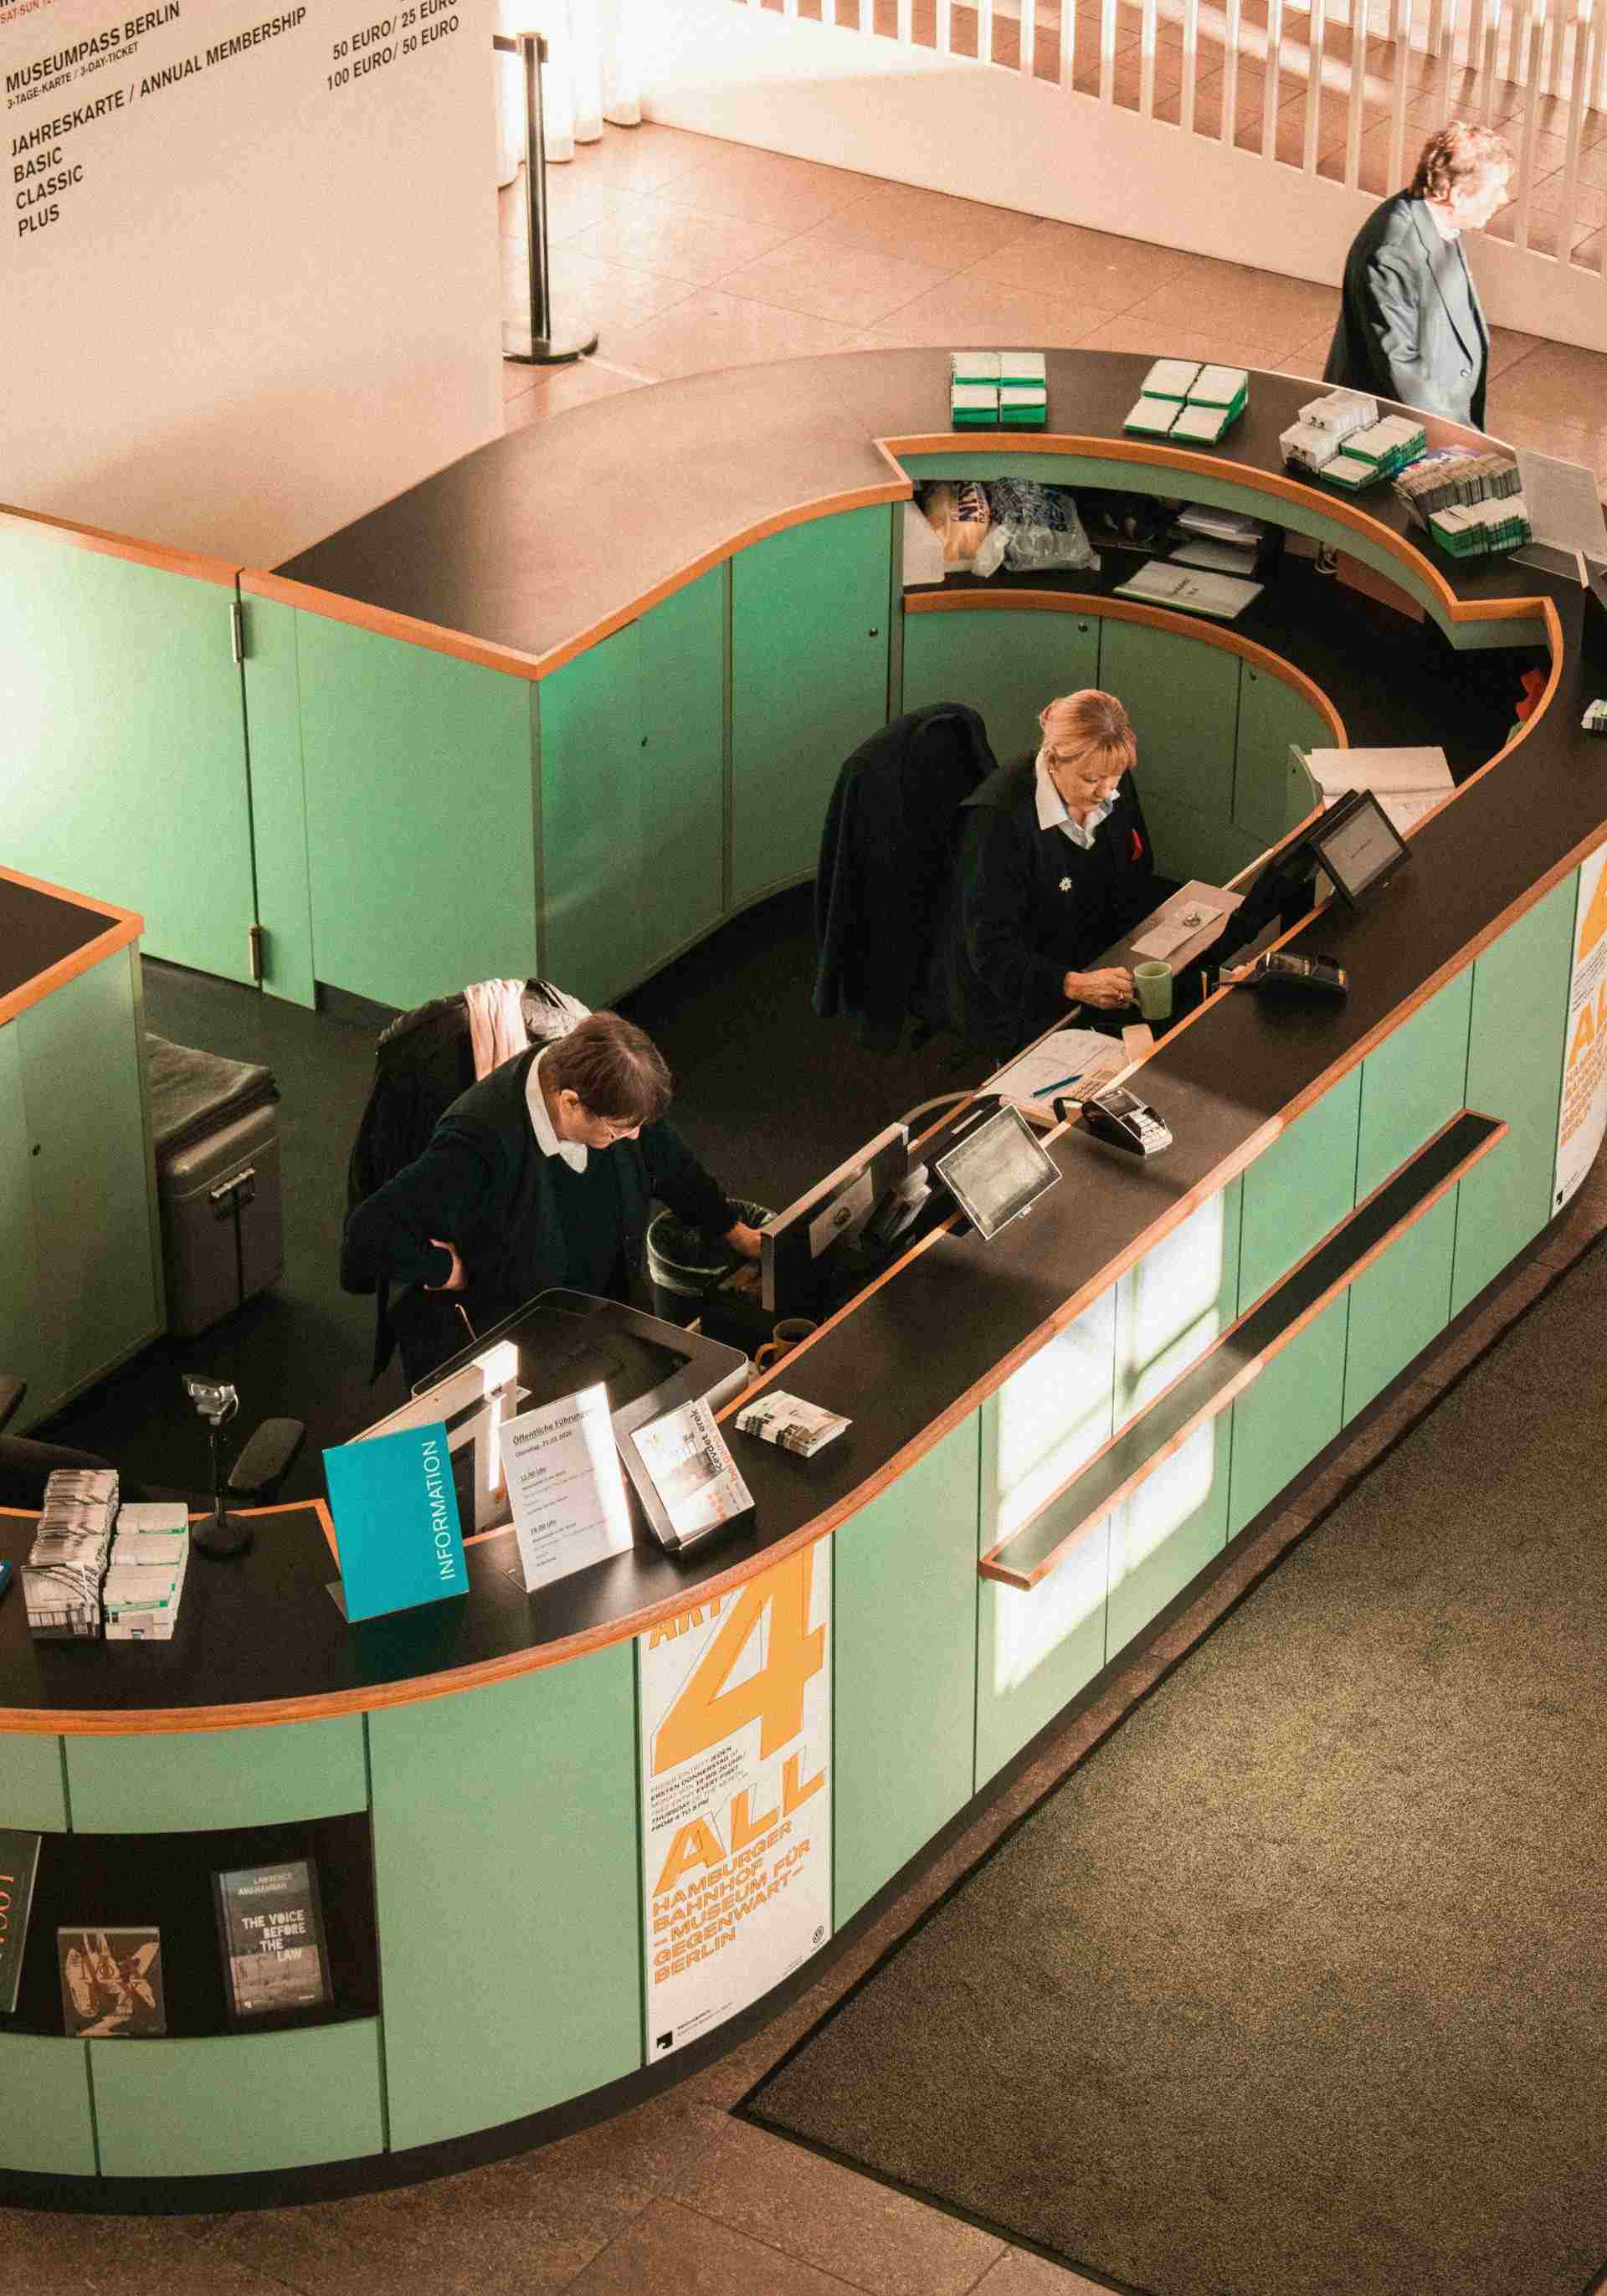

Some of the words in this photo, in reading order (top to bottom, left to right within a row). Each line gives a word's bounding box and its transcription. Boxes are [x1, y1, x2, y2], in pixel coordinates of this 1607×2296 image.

[6, 28, 121, 93] MUSEUMPASS
[125, 1, 180, 40] BERLIN
[327, 68, 349, 90] 100
[403, 35, 417, 54] 50
[421, 15, 459, 47] EURO
[333, 41, 348, 60] 50
[401, 8, 416, 28] 25
[7, 71, 72, 110] 3-TAGE-KARTE
[80, 42, 140, 77] 3-DAY-TICKET
[12, 90, 125, 157] JAHRESKARTE
[141, 58, 202, 97] ANNUAL
[206, 7, 307, 67] MEMBERSHIP
[13, 147, 63, 184] BASIC
[16, 165, 84, 210] CLASSIC
[18, 203, 60, 238] PLUS
[421, 1440, 455, 1580] INFORMATION
[650, 1542, 826, 1777] 4
[653, 1744, 827, 1898] ALL
[653, 1820, 792, 1916] HAMBURGER
[653, 1857, 763, 1934] BAHNHOF
[241, 1914, 265, 1929] THE
[269, 1909, 305, 1925] VOICE
[263, 1922, 306, 1939] BEFORE
[671, 1872, 767, 1941] MUSEUM
[259, 1938, 283, 1952] THE
[277, 1948, 302, 1962] LAW
[655, 1927, 737, 1984] BERLIN
